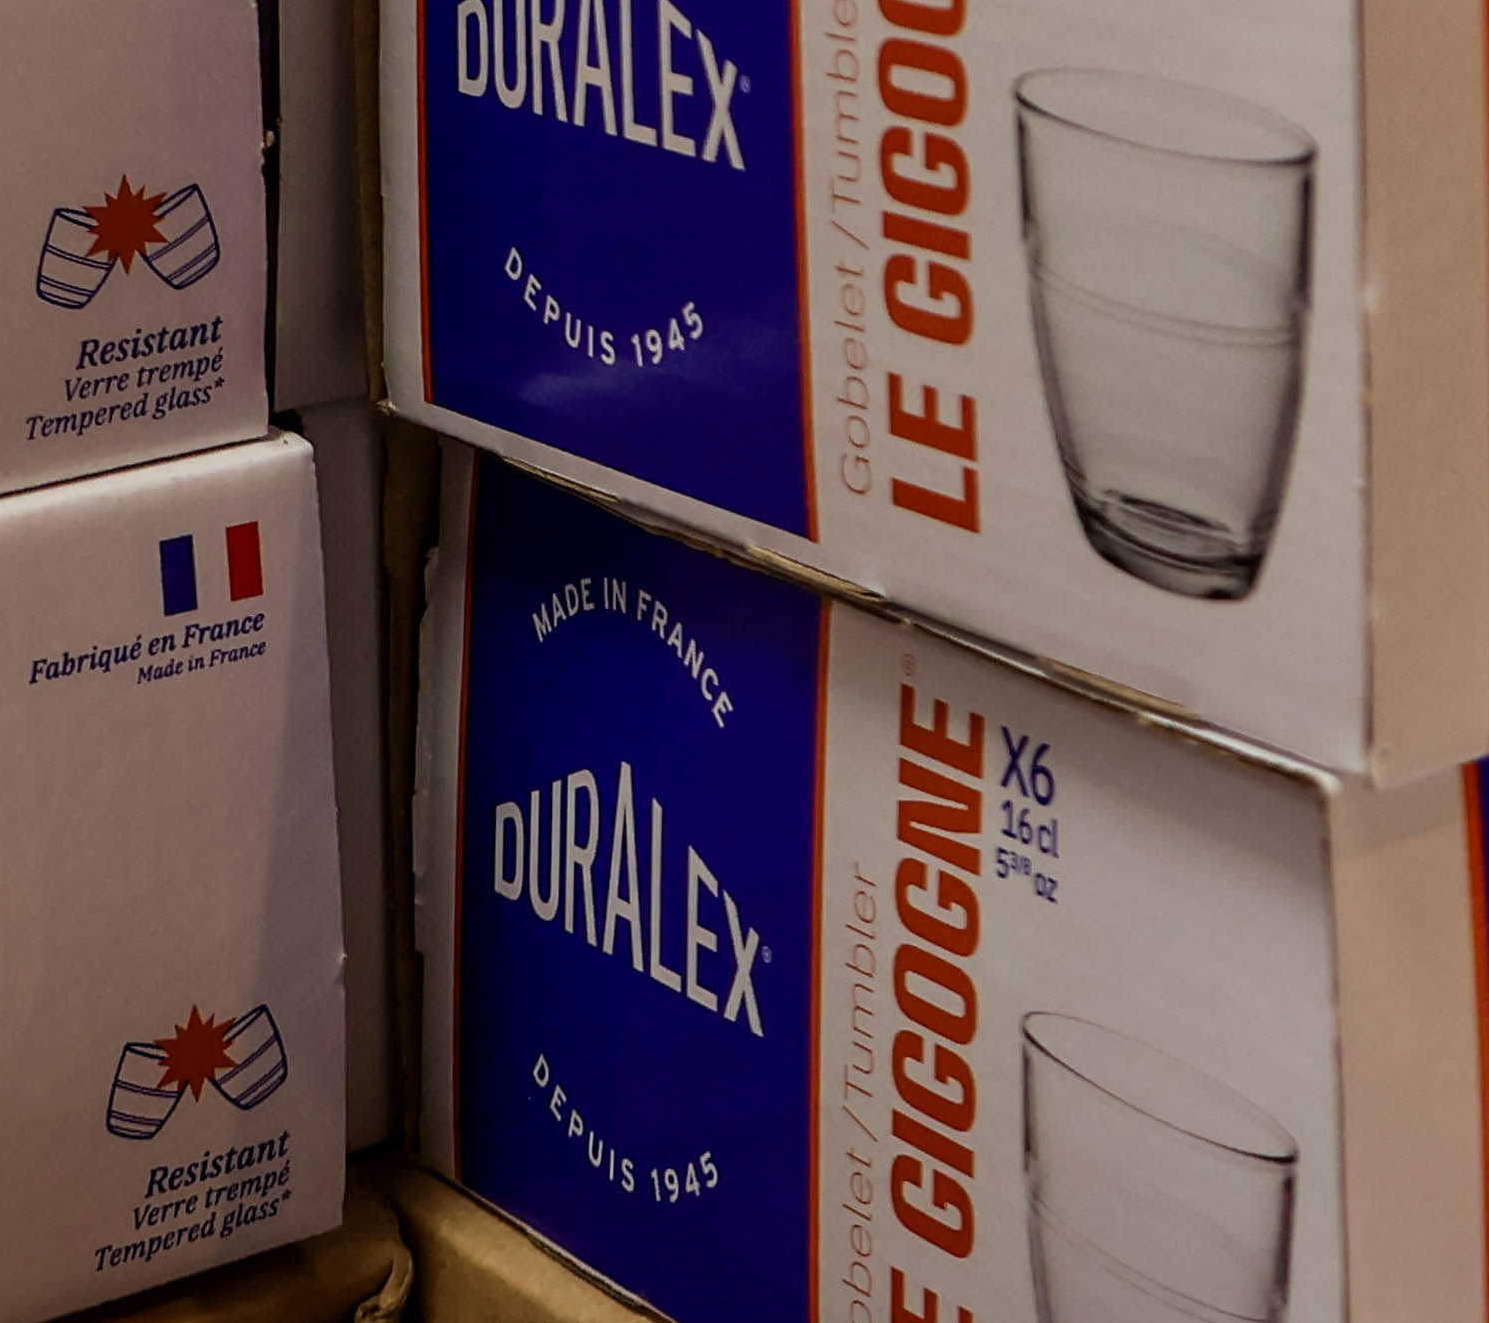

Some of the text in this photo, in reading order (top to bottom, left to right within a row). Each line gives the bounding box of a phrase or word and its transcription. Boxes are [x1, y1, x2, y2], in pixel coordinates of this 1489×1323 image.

[75, 315, 223, 370] Resistant
[503, 247, 703, 367] DEPUIS 1945
[64, 347, 223, 401] Verre trempé
[26, 393, 147, 441] Tempered
[888, 372, 980, 533] LE
[28, 613, 265, 685] Fabriqué en France
[137, 641, 266, 684] Made in France
[532, 577, 733, 728] MADE IN FRANCE
[1001, 725, 1055, 806] X6
[533, 1053, 720, 1204] DEPUIS 1945
[133, 1159, 291, 1231] Verre trempé
[145, 1131, 291, 1199] Resistant
[95, 1212, 215, 1272] Tempered
